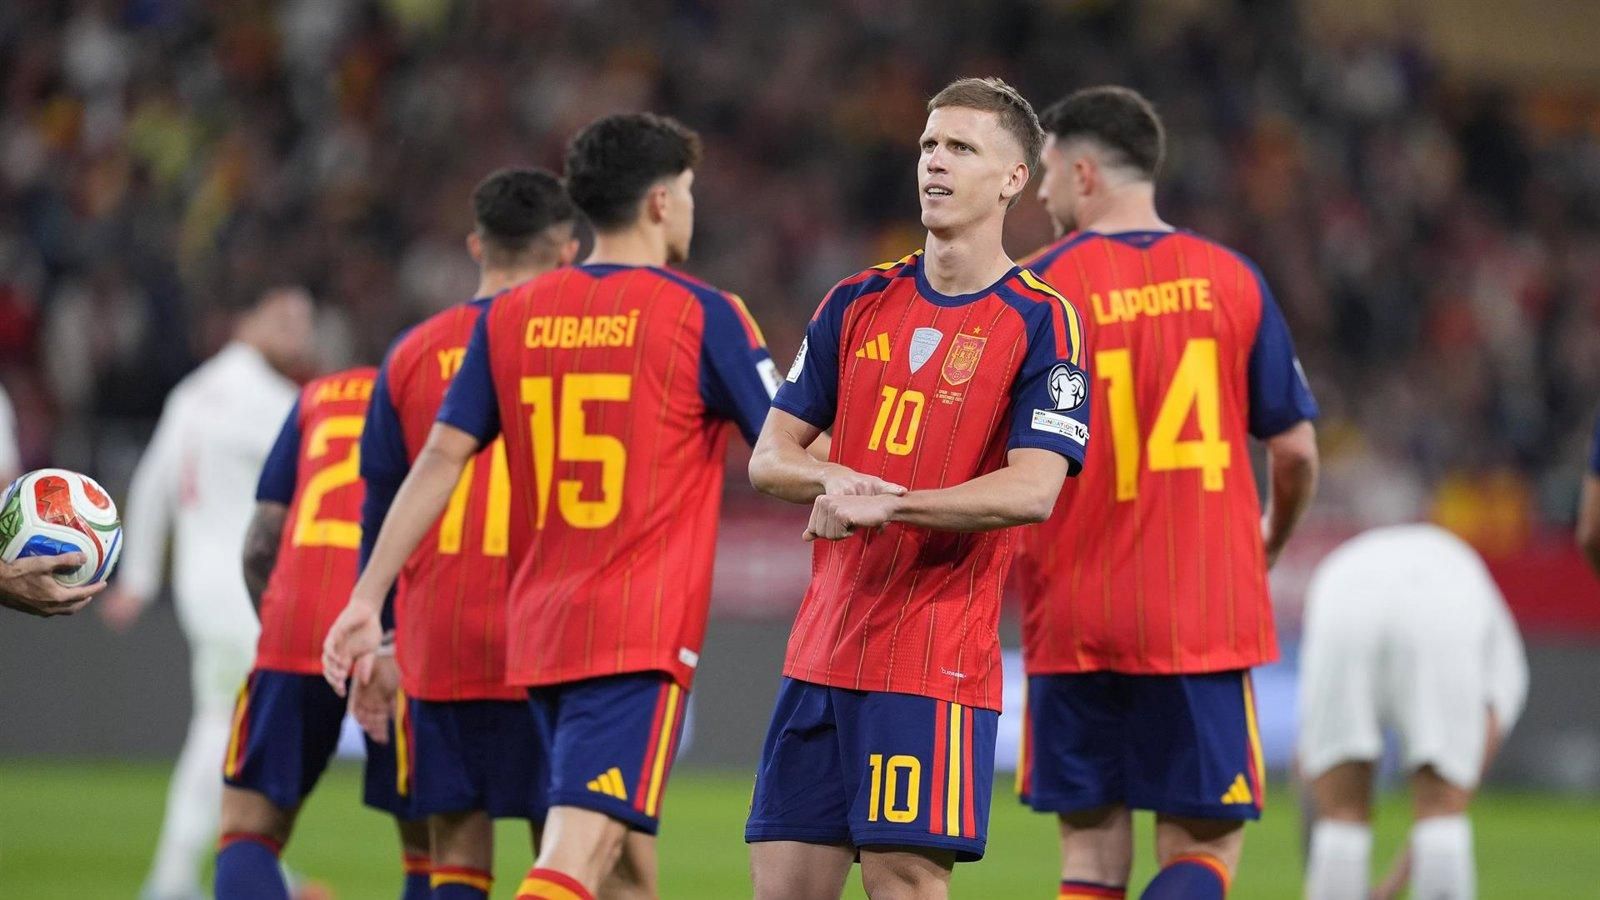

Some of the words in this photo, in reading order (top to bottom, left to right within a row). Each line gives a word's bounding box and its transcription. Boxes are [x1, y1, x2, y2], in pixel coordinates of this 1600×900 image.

[524, 308, 641, 349] CUBARSÍ
[1090, 277, 1214, 325] LAPORTE
[520, 372, 632, 530] 15
[867, 384, 926, 456] 10
[1094, 338, 1231, 502] 14
[867, 753, 922, 824] 10
